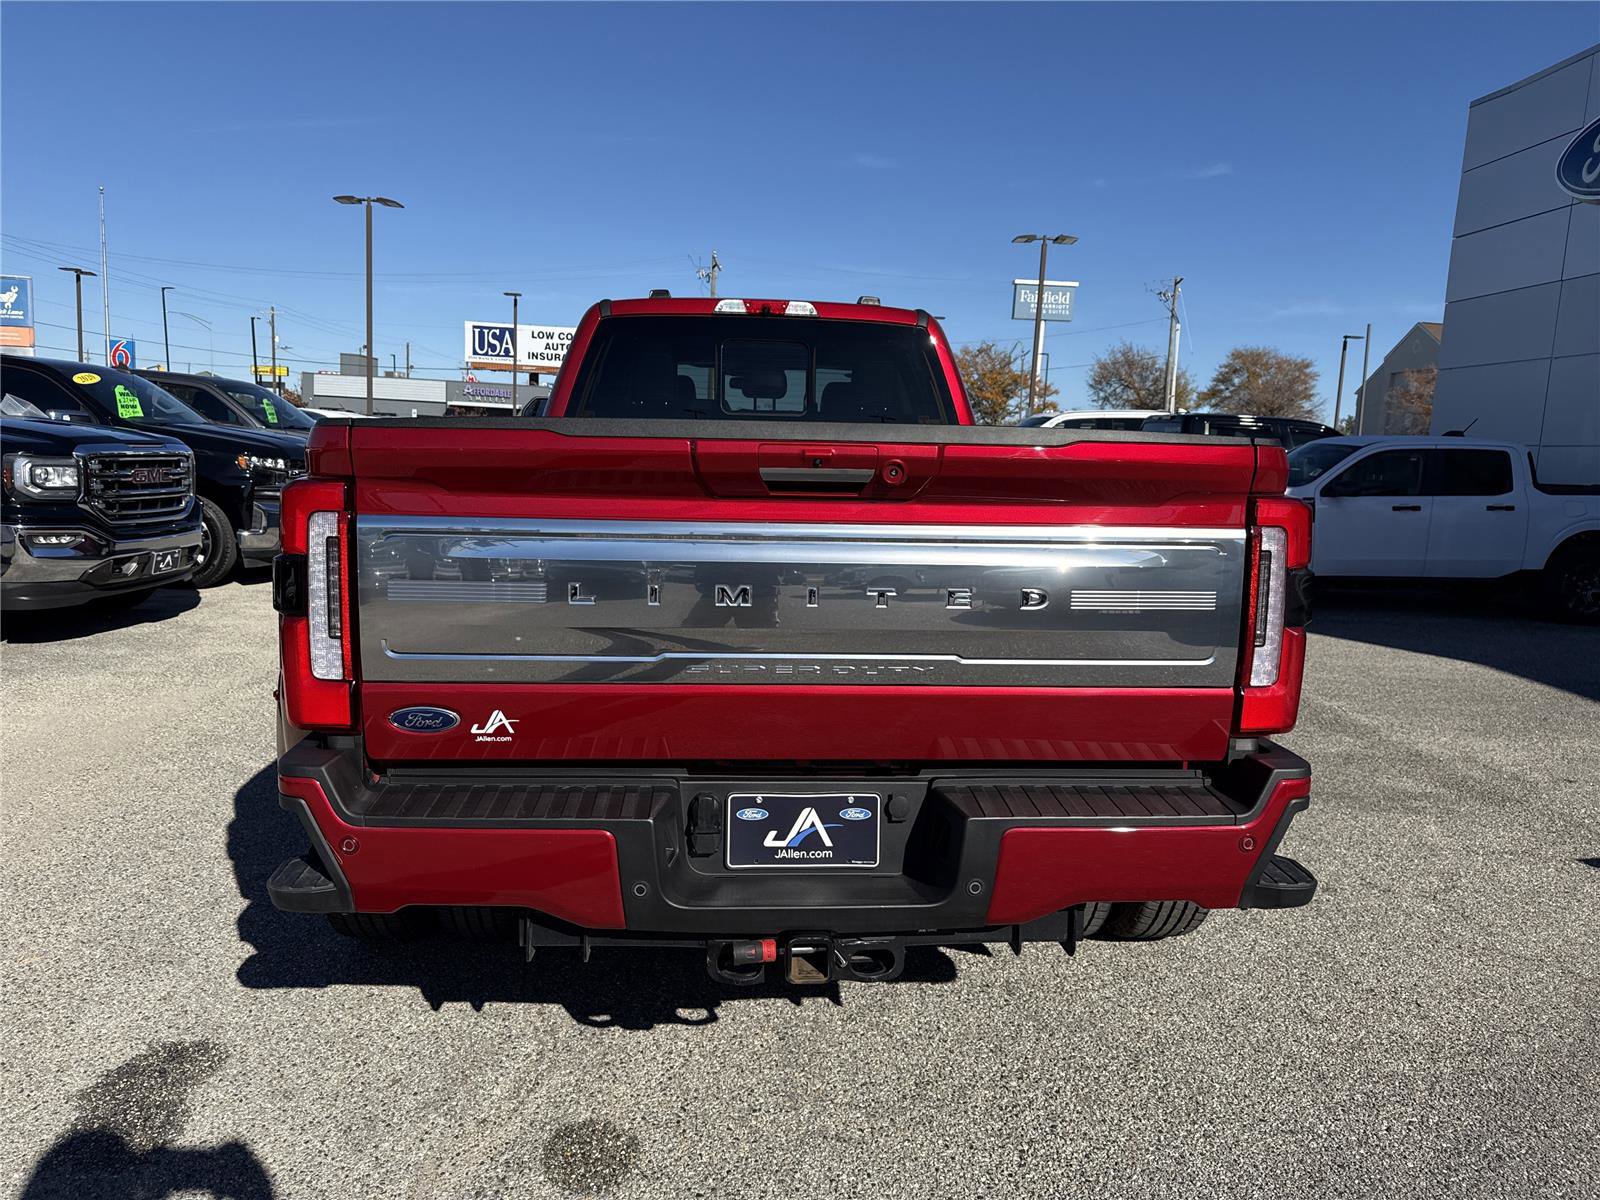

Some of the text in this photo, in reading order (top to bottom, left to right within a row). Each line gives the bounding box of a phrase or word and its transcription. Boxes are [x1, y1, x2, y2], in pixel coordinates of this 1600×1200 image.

[1020, 289, 1070, 304] Faifield
[473, 328, 515, 356] USA
[531, 330, 574, 341] LOW CO
[111, 341, 130, 368] 6
[528, 351, 567, 362] INSUR
[132, 467, 173, 484] GMC
[567, 581, 1050, 612] LIMITED
[685, 664, 936, 675] SUPER DUTY
[404, 711, 443, 728] Ford
[742, 809, 764, 819] Ford
[846, 809, 867, 819] Ford
[774, 849, 833, 859] JAllen.com
